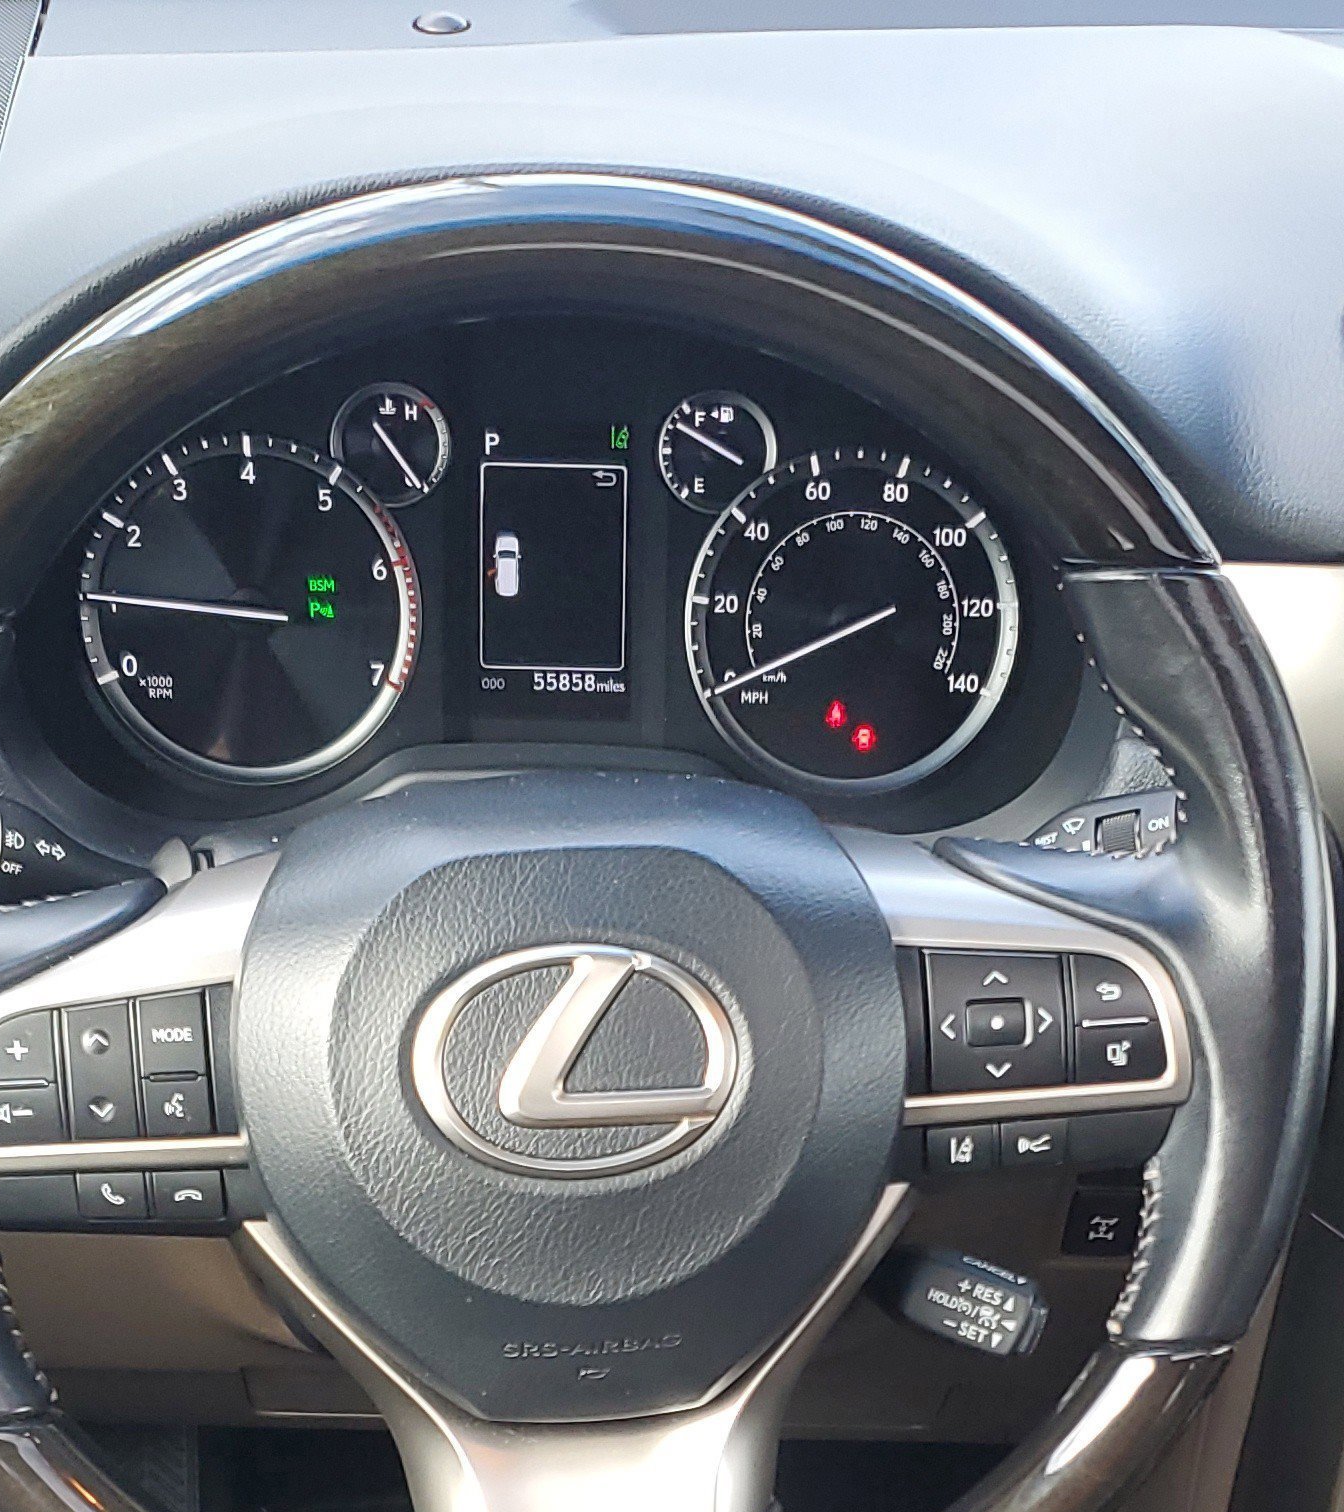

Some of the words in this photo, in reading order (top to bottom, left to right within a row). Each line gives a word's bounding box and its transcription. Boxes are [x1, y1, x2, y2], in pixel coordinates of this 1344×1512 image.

[405, 405, 417, 420] H
[695, 411, 706, 427] F
[484, 430, 500, 455] P
[240, 461, 256, 485] 4
[172, 480, 187, 501] 3
[694, 477, 706, 494] E
[805, 481, 831, 501] 60
[883, 483, 909, 503] 80
[317, 489, 333, 512] 5
[744, 521, 769, 541] 40
[825, 517, 845, 533] 100
[859, 517, 878, 532] 120
[126, 525, 142, 548] 2
[795, 531, 811, 547] 80
[893, 527, 911, 545] 140
[933, 526, 967, 548] 100
[770, 555, 784, 572] 60
[918, 547, 935, 569] 160
[372, 558, 387, 581] 6
[309, 578, 336, 593] BSM
[755, 586, 768, 603] 40
[936, 579, 950, 601] 180
[714, 594, 739, 614] 20
[962, 596, 994, 618] 120
[752, 622, 763, 640] 20
[942, 613, 953, 636] 200
[122, 652, 138, 676] 0
[933, 646, 949, 671] 220
[369, 661, 385, 686] 7
[481, 677, 505, 690] ODO
[532, 672, 596, 692] 55858
[762, 669, 788, 684] km/h
[947, 673, 980, 694] 140
[149, 688, 174, 700] RPM
[740, 691, 769, 705] MPH
[1147, 815, 1171, 832] ON
[0, 859, 24, 876] OFF
[151, 1026, 194, 1044] MODE
[972, 1282, 1004, 1306] RES
[957, 1320, 990, 1344] SET
